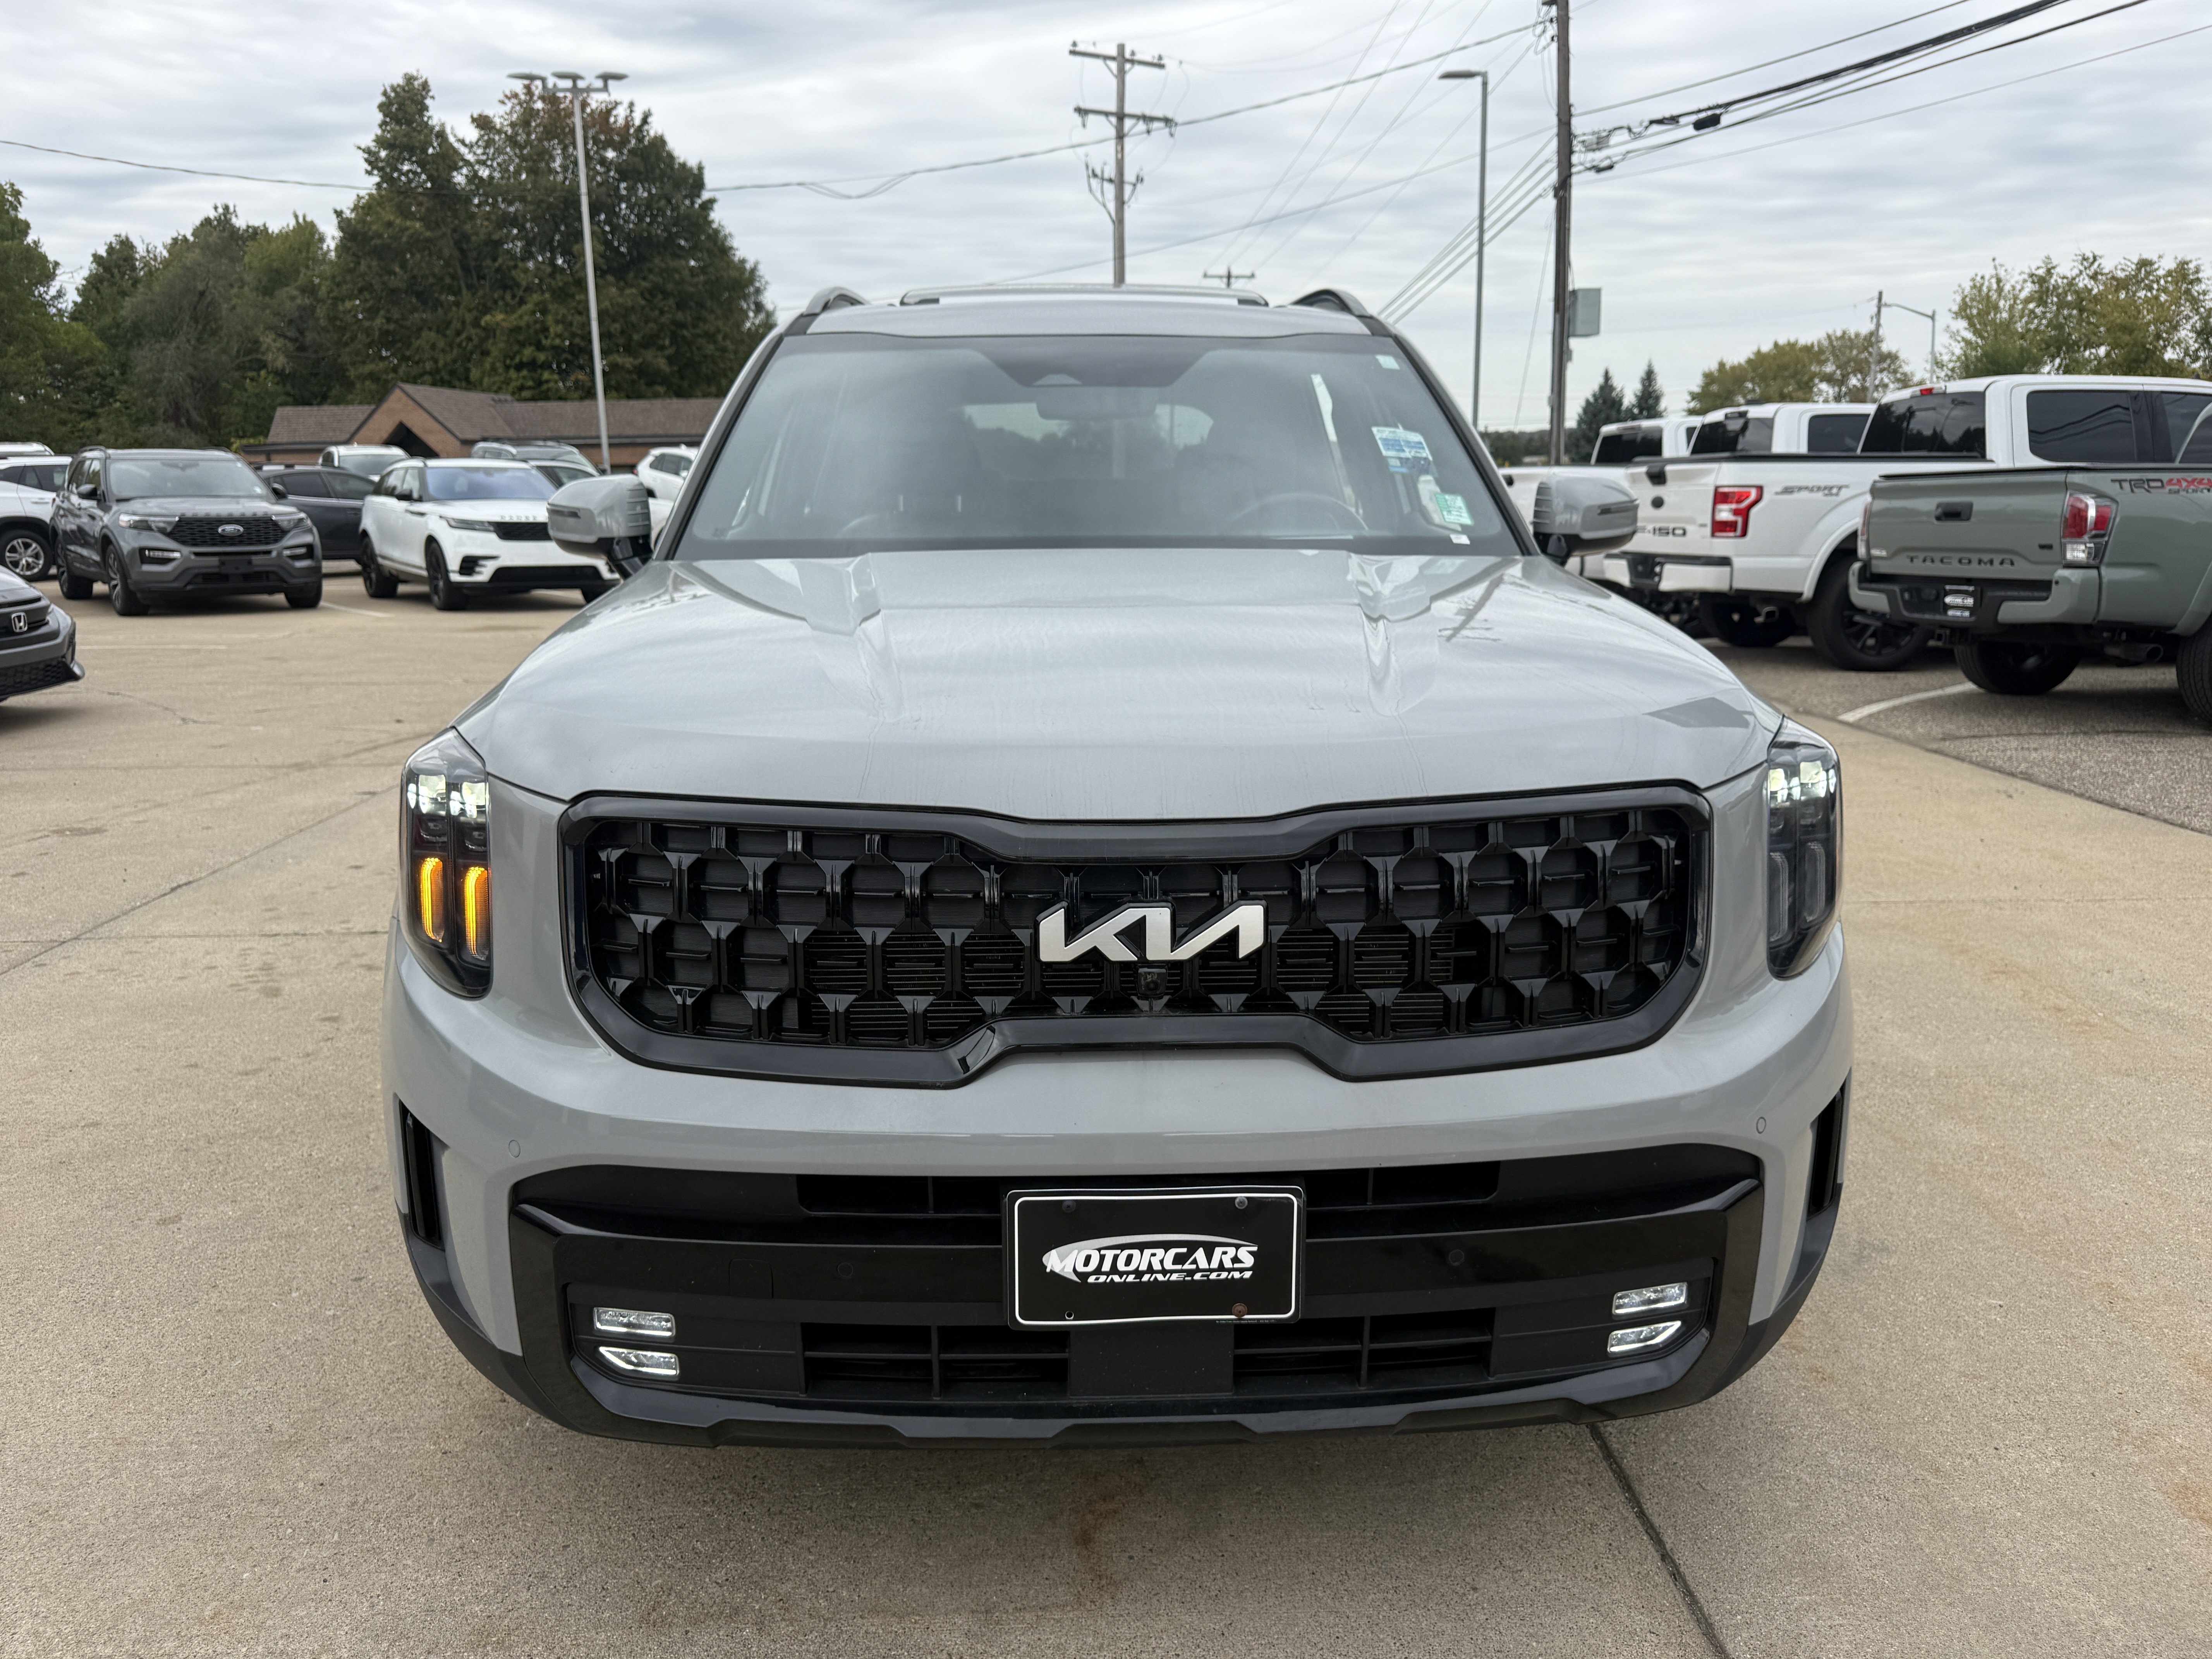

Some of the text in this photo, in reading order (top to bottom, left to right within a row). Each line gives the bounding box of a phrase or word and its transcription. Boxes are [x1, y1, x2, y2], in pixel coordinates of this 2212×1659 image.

[2111, 478, 2165, 493] TRD
[1907, 555, 2015, 567] TACOMA
[1039, 905, 1264, 962] KIA
[1046, 1246, 1258, 1273] MOTORCARS
[1087, 1271, 1254, 1283] ONLINE.COM
